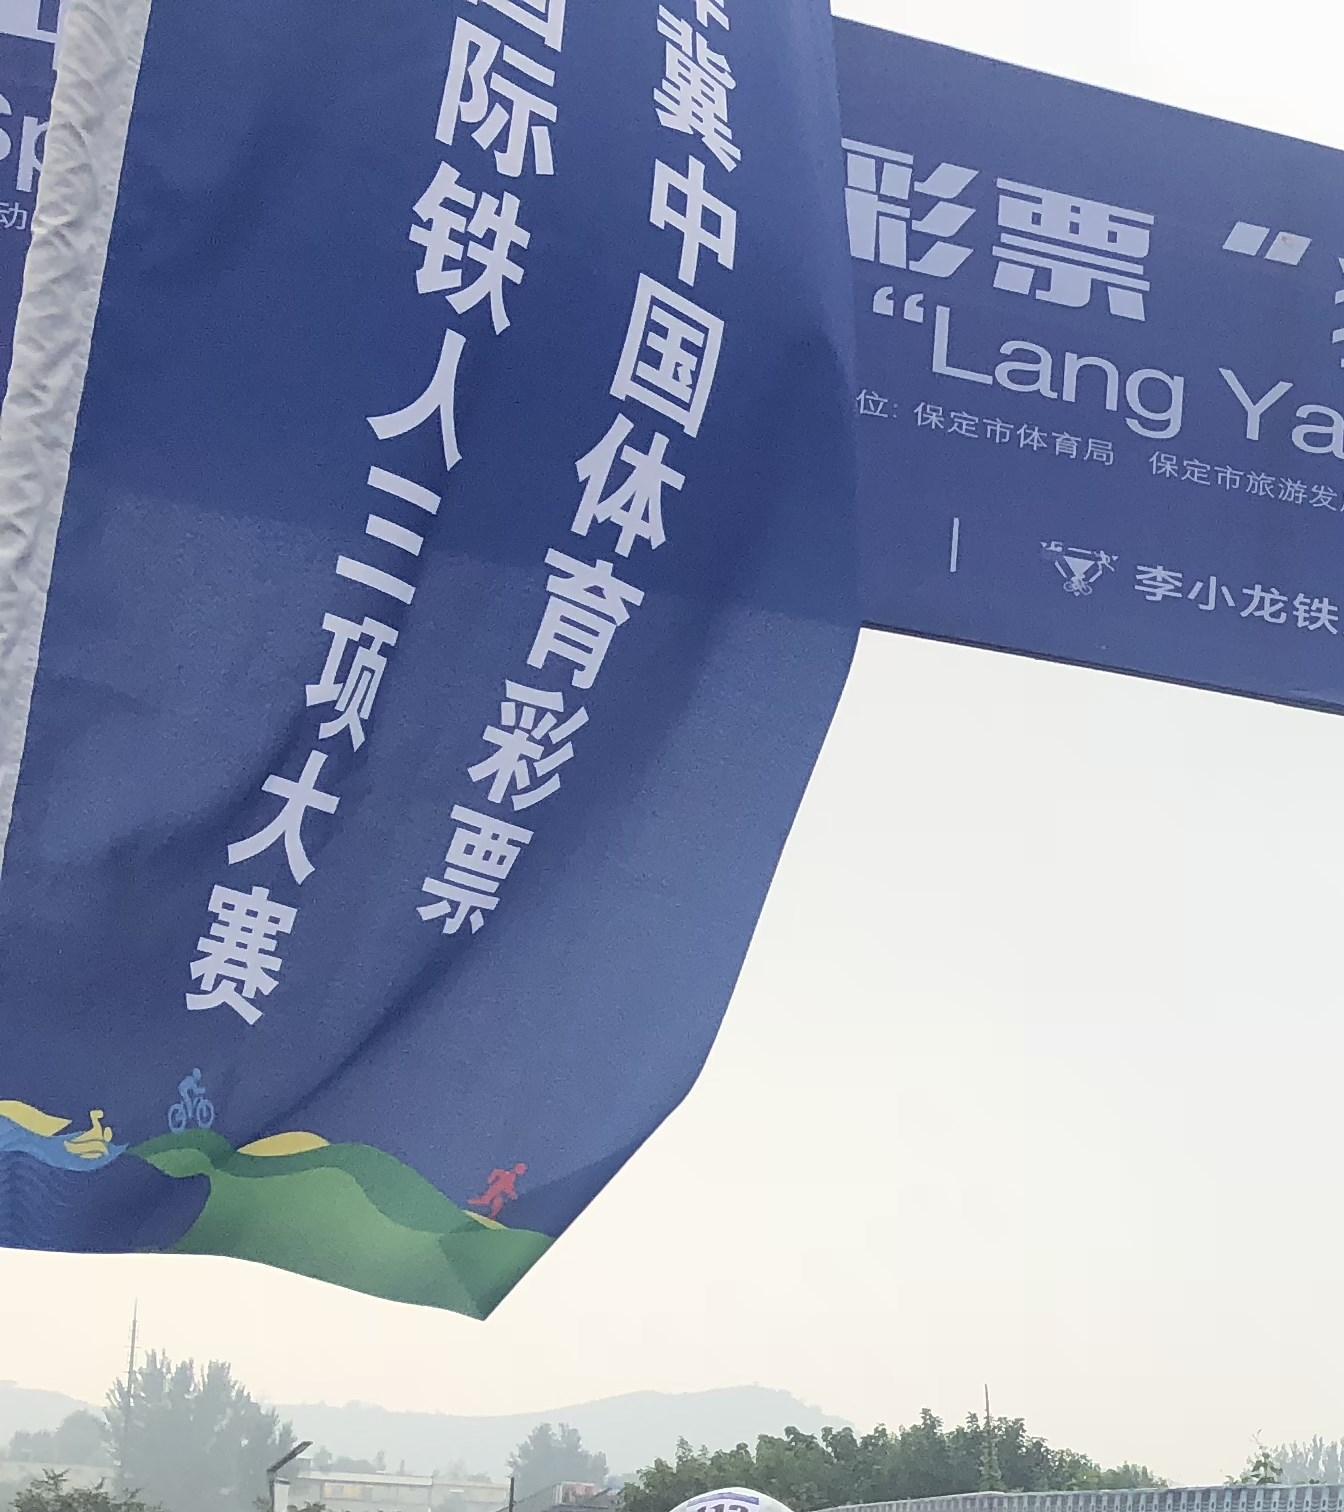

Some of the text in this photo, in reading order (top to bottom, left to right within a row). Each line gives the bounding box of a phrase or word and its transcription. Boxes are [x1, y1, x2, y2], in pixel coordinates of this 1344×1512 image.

[416, 0, 741, 935] 冀中国体育彩票
[914, 402, 1114, 465] 保定市体育局
